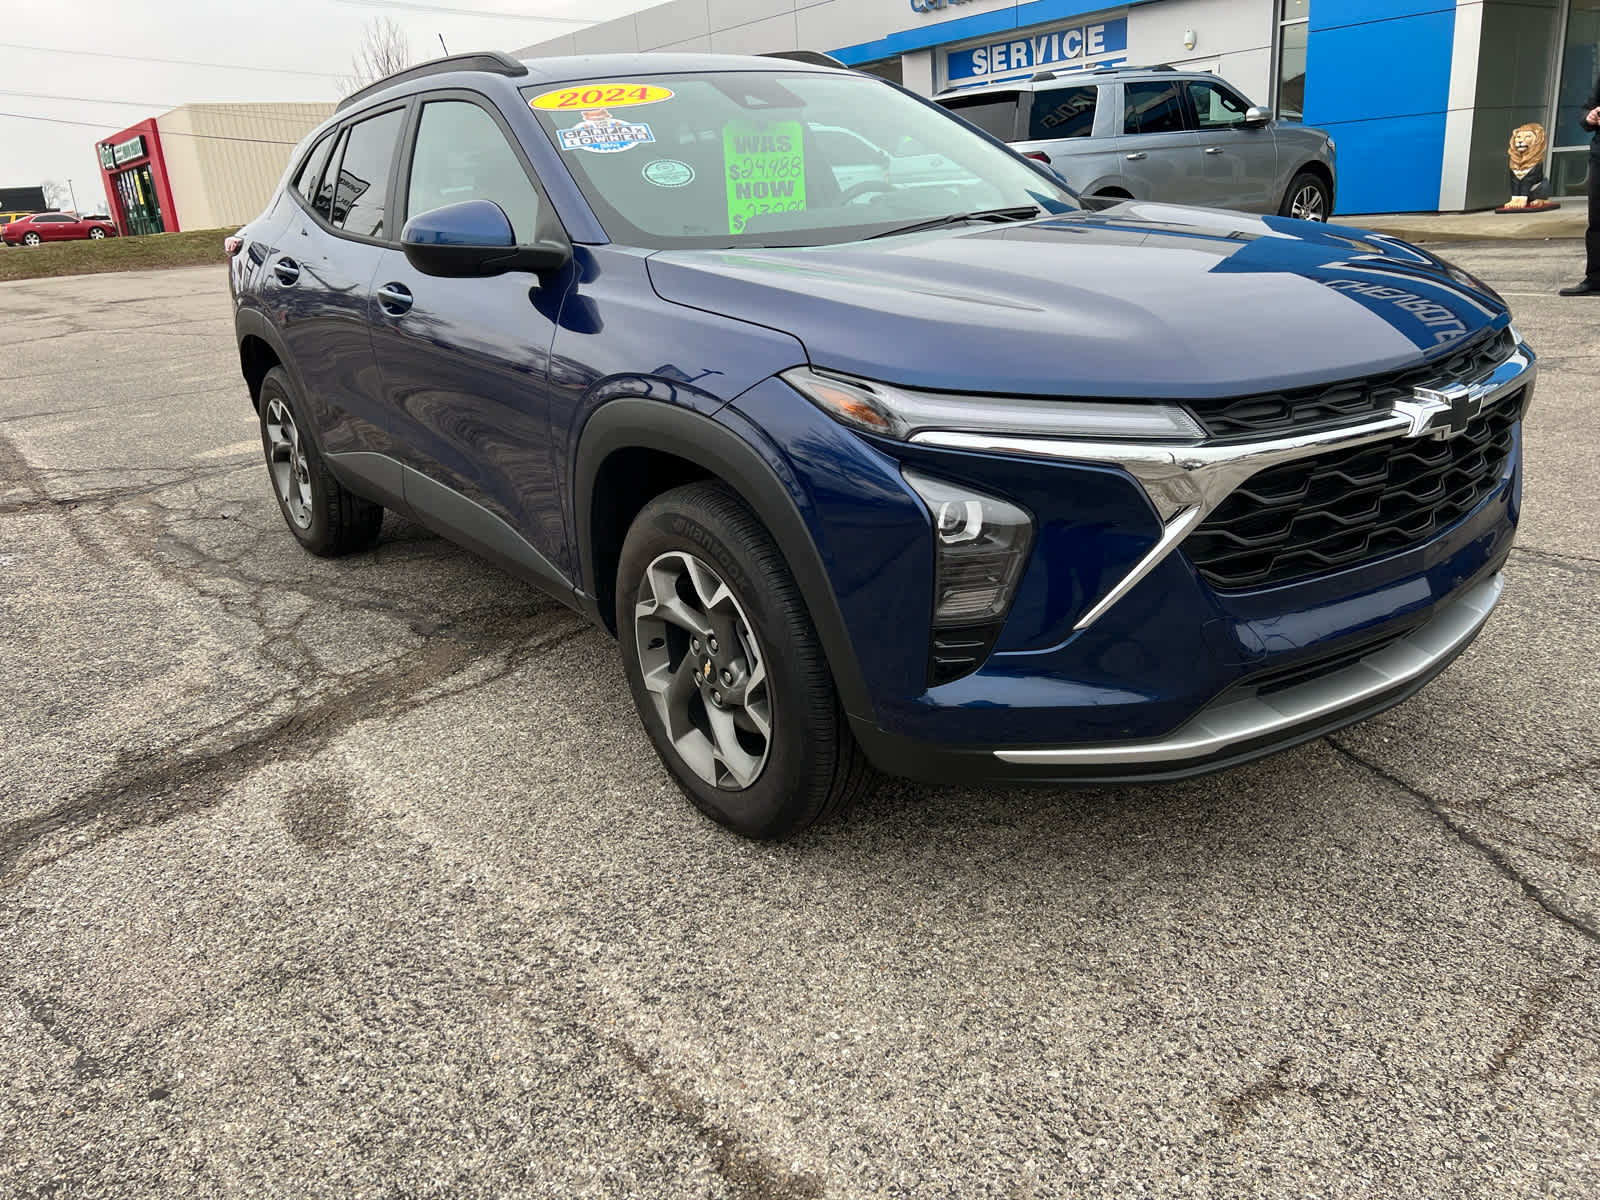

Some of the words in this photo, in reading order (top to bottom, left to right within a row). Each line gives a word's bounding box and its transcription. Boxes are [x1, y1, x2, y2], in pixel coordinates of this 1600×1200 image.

[972, 25, 1105, 75] SERVICE
[558, 87, 650, 108] 2024
[563, 127, 643, 139] CARFAX
[580, 134, 649, 144] OWNER
[734, 135, 793, 154] WAS
[735, 180, 795, 200] NOW
